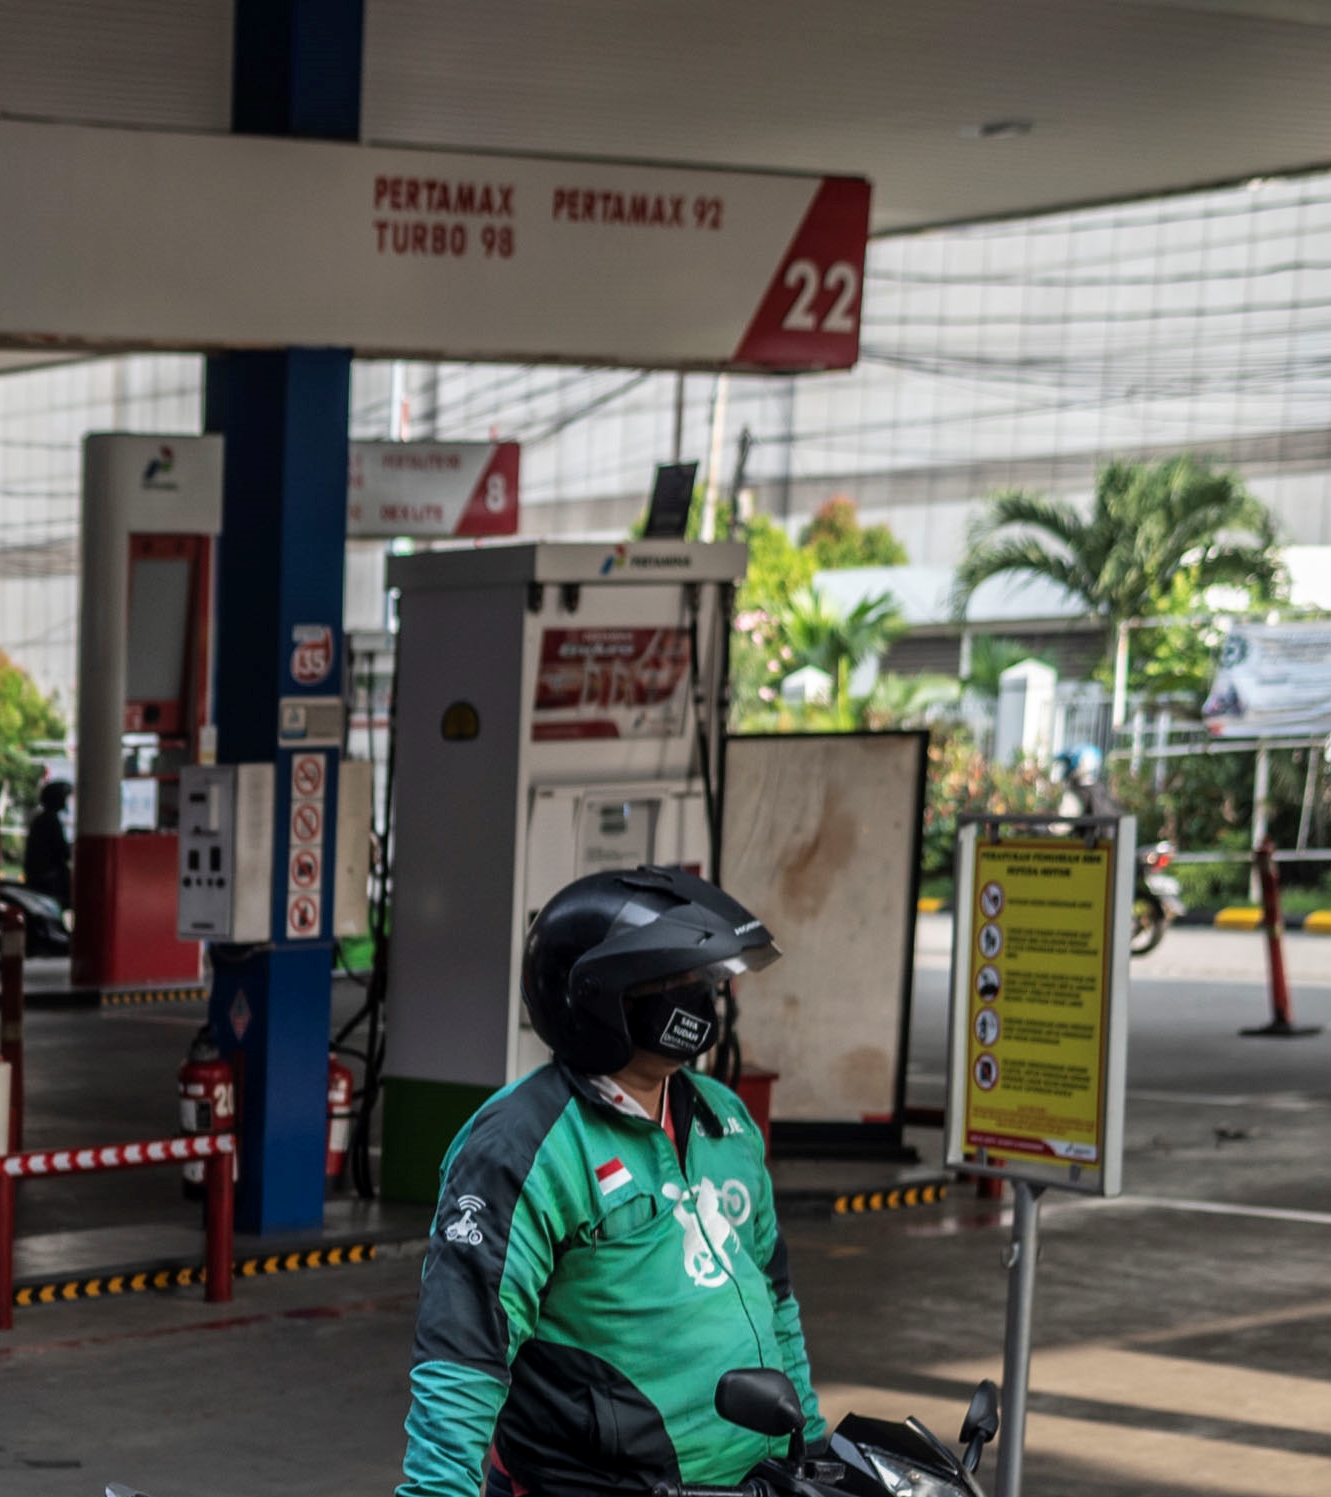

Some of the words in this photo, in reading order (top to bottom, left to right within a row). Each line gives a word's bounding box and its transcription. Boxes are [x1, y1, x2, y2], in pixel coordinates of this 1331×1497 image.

[374, 176, 514, 216] PERTAMAX
[552, 188, 684, 228] PERTAMAX
[693, 197, 724, 231] 92
[374, 221, 467, 257] TURBO
[481, 224, 515, 258] 98
[782, 259, 856, 333] 22
[486, 473, 507, 514] 8
